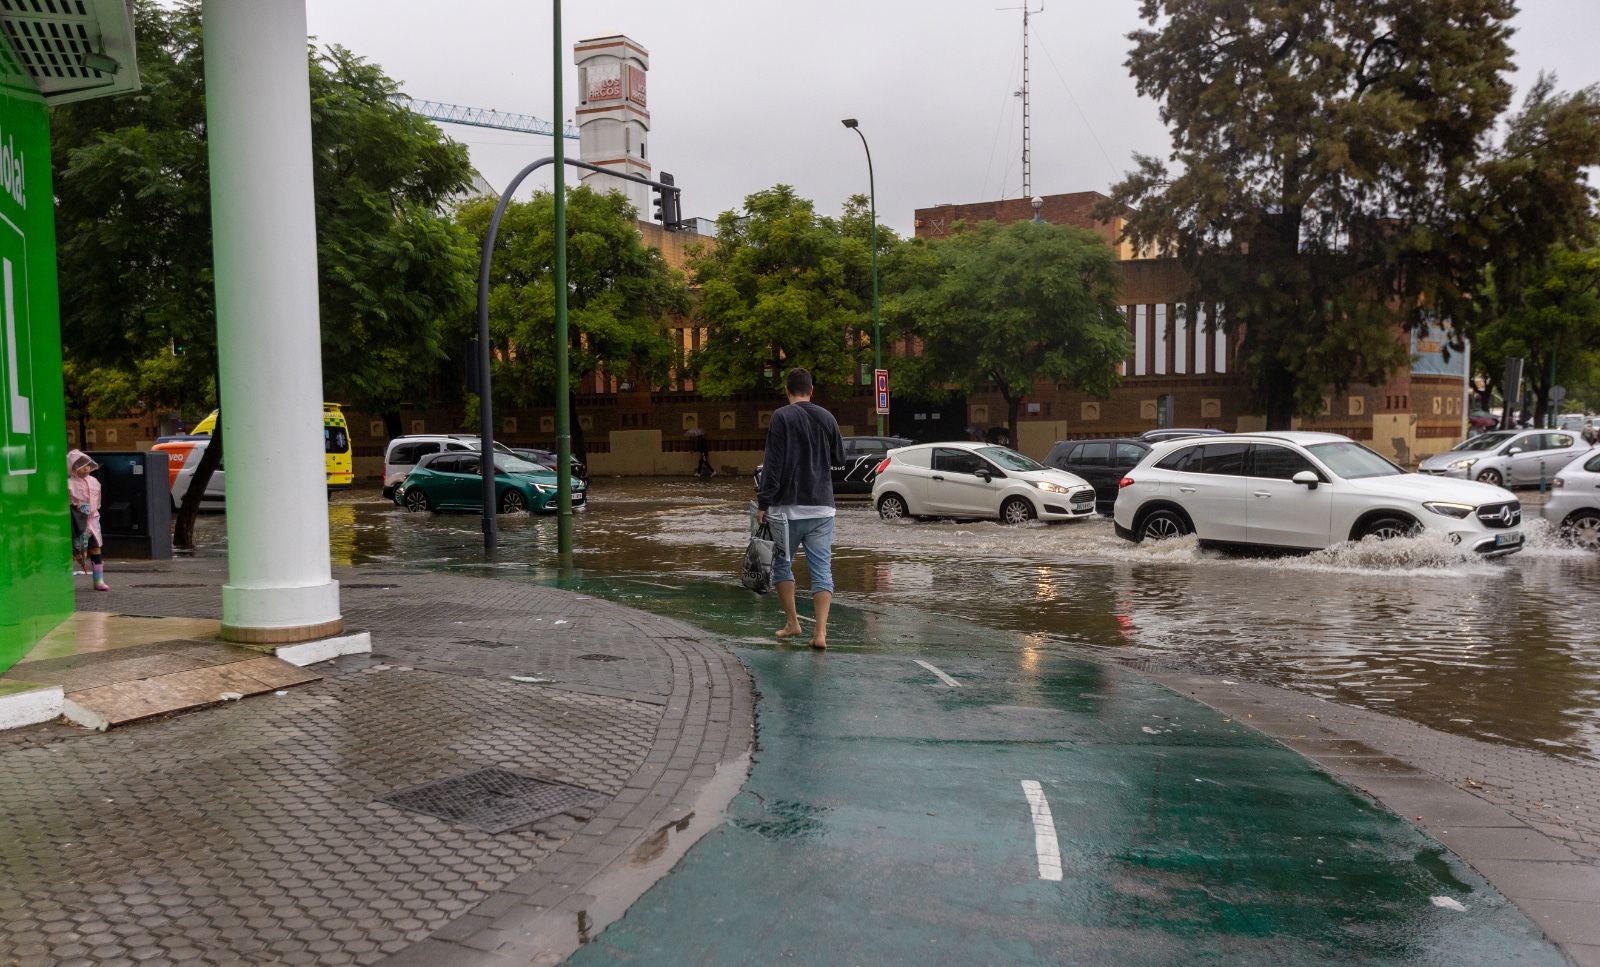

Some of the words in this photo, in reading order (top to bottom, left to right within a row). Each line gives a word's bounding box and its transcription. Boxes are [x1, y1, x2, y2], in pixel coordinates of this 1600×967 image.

[602, 78, 619, 88] LOS
[589, 87, 620, 98] ARCOS
[0, 124, 26, 210] ola!
